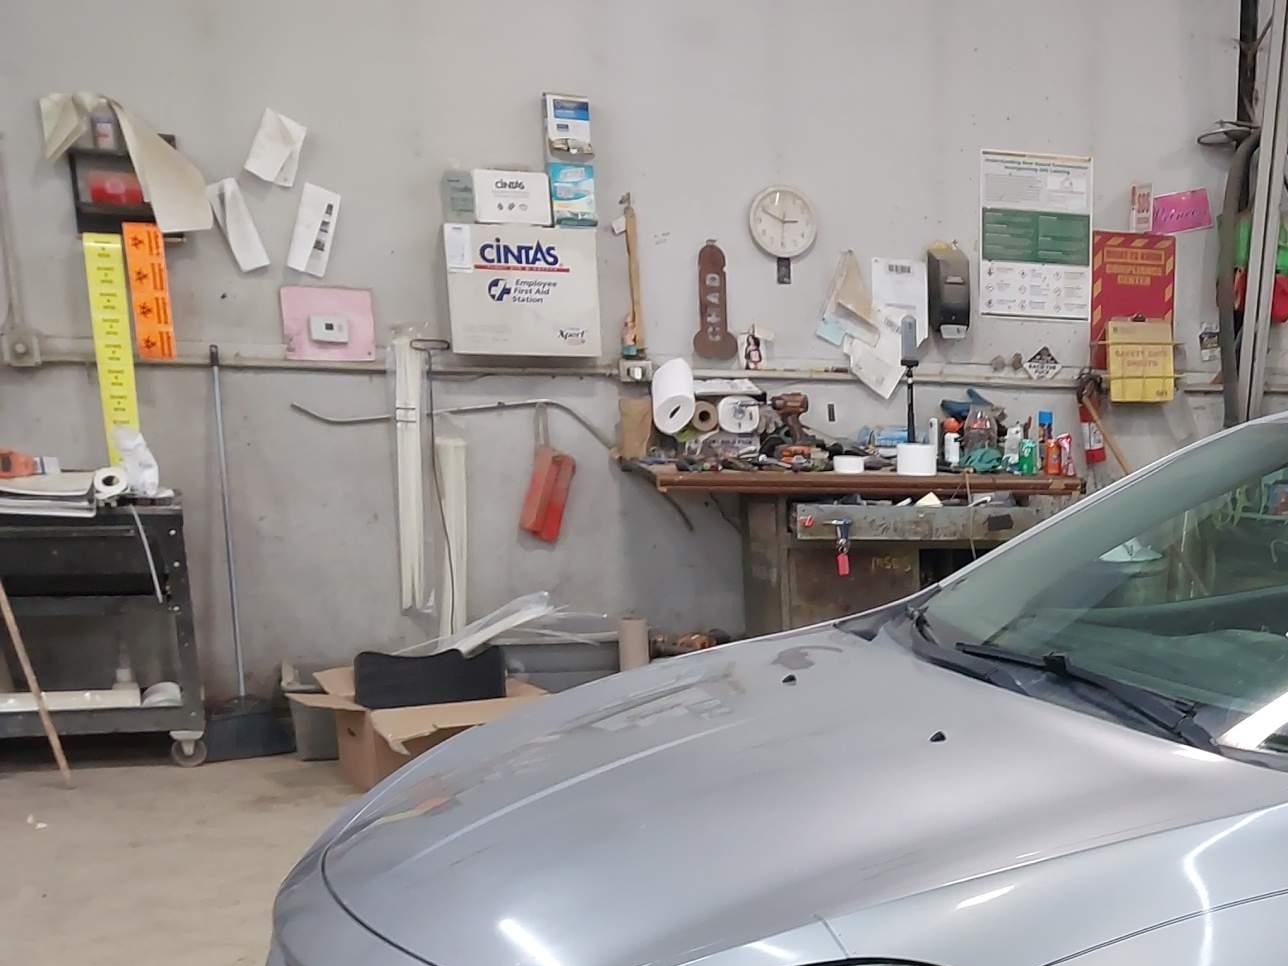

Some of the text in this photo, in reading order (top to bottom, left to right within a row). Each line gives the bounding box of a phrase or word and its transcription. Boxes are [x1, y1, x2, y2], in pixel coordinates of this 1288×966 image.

[479, 236, 559, 267] CINTAS
[515, 279, 557, 289] Employee
[513, 287, 550, 296] First Aid
[512, 295, 544, 303] Station
